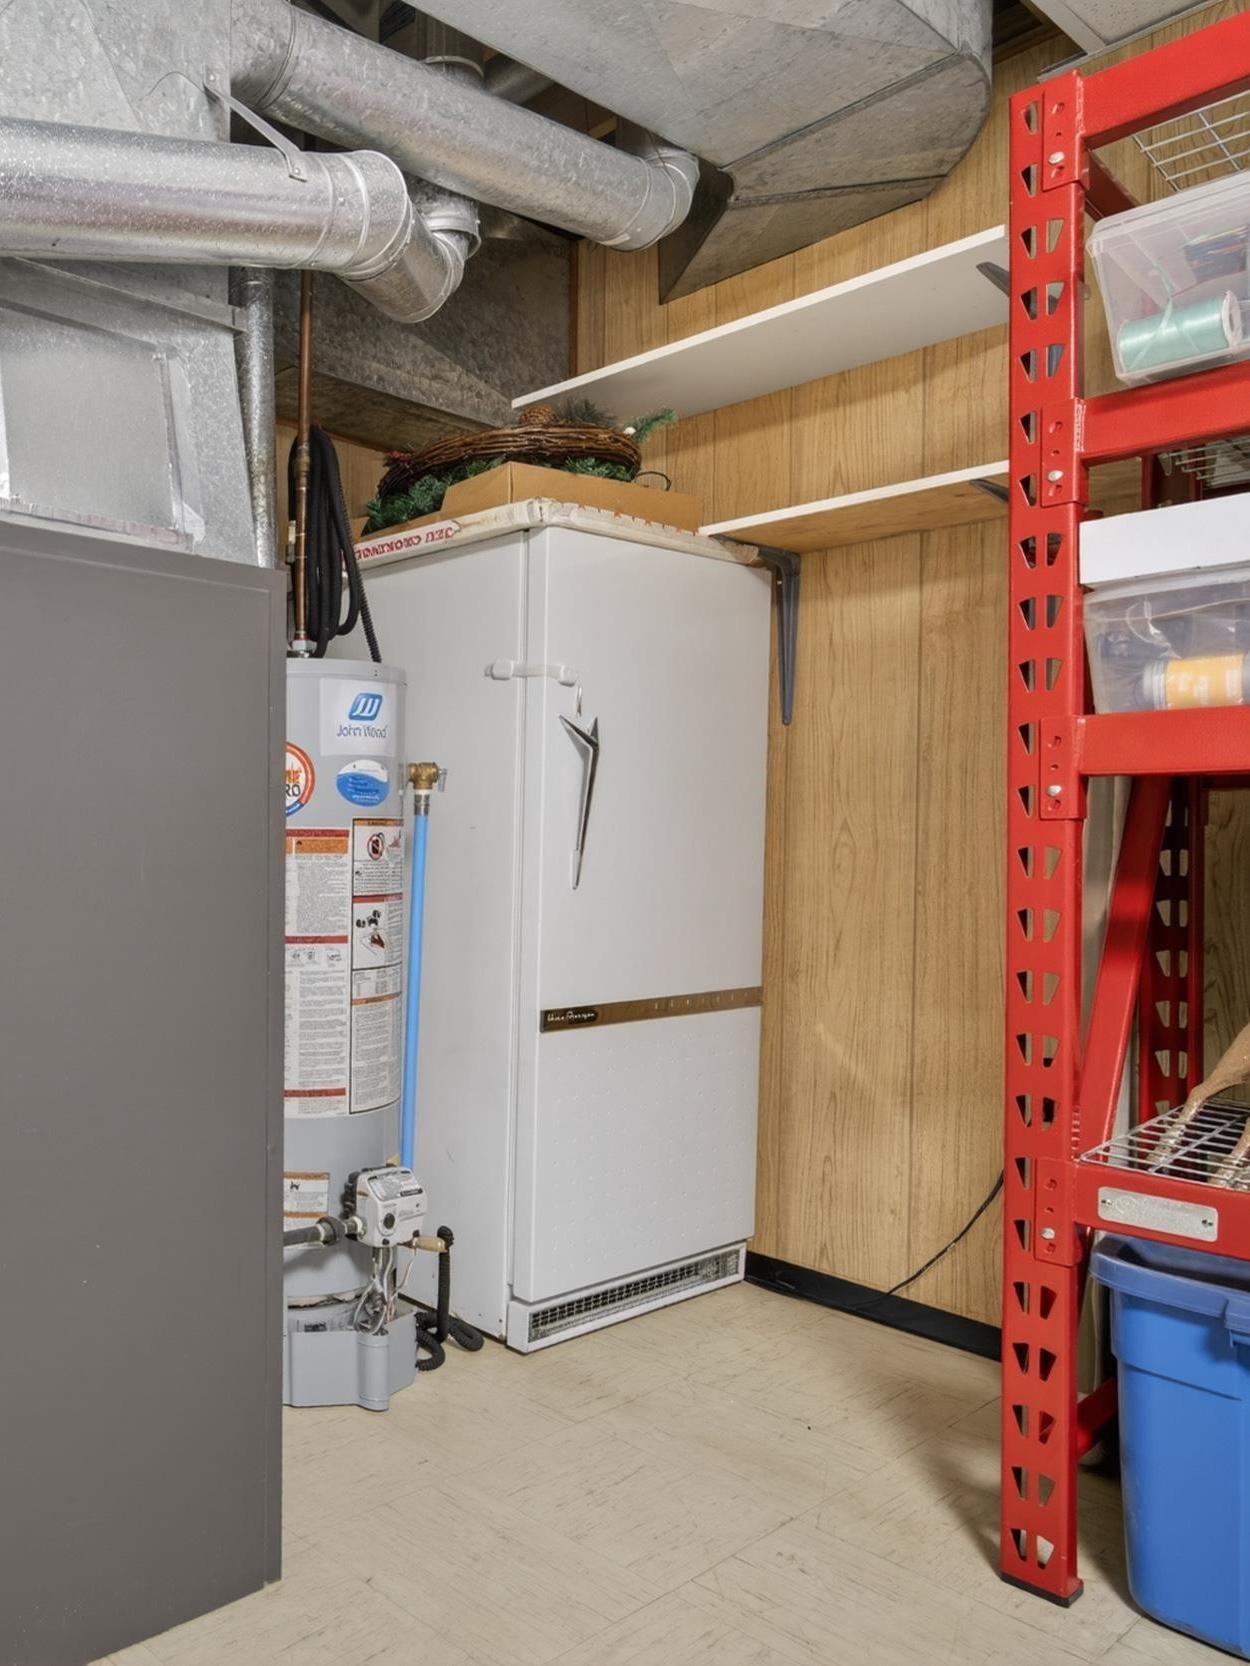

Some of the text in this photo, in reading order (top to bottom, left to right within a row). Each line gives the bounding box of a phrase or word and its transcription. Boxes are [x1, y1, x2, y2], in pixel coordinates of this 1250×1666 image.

[354, 535, 422, 560] CROKINOL
[337, 726, 387, 738] John Wood
